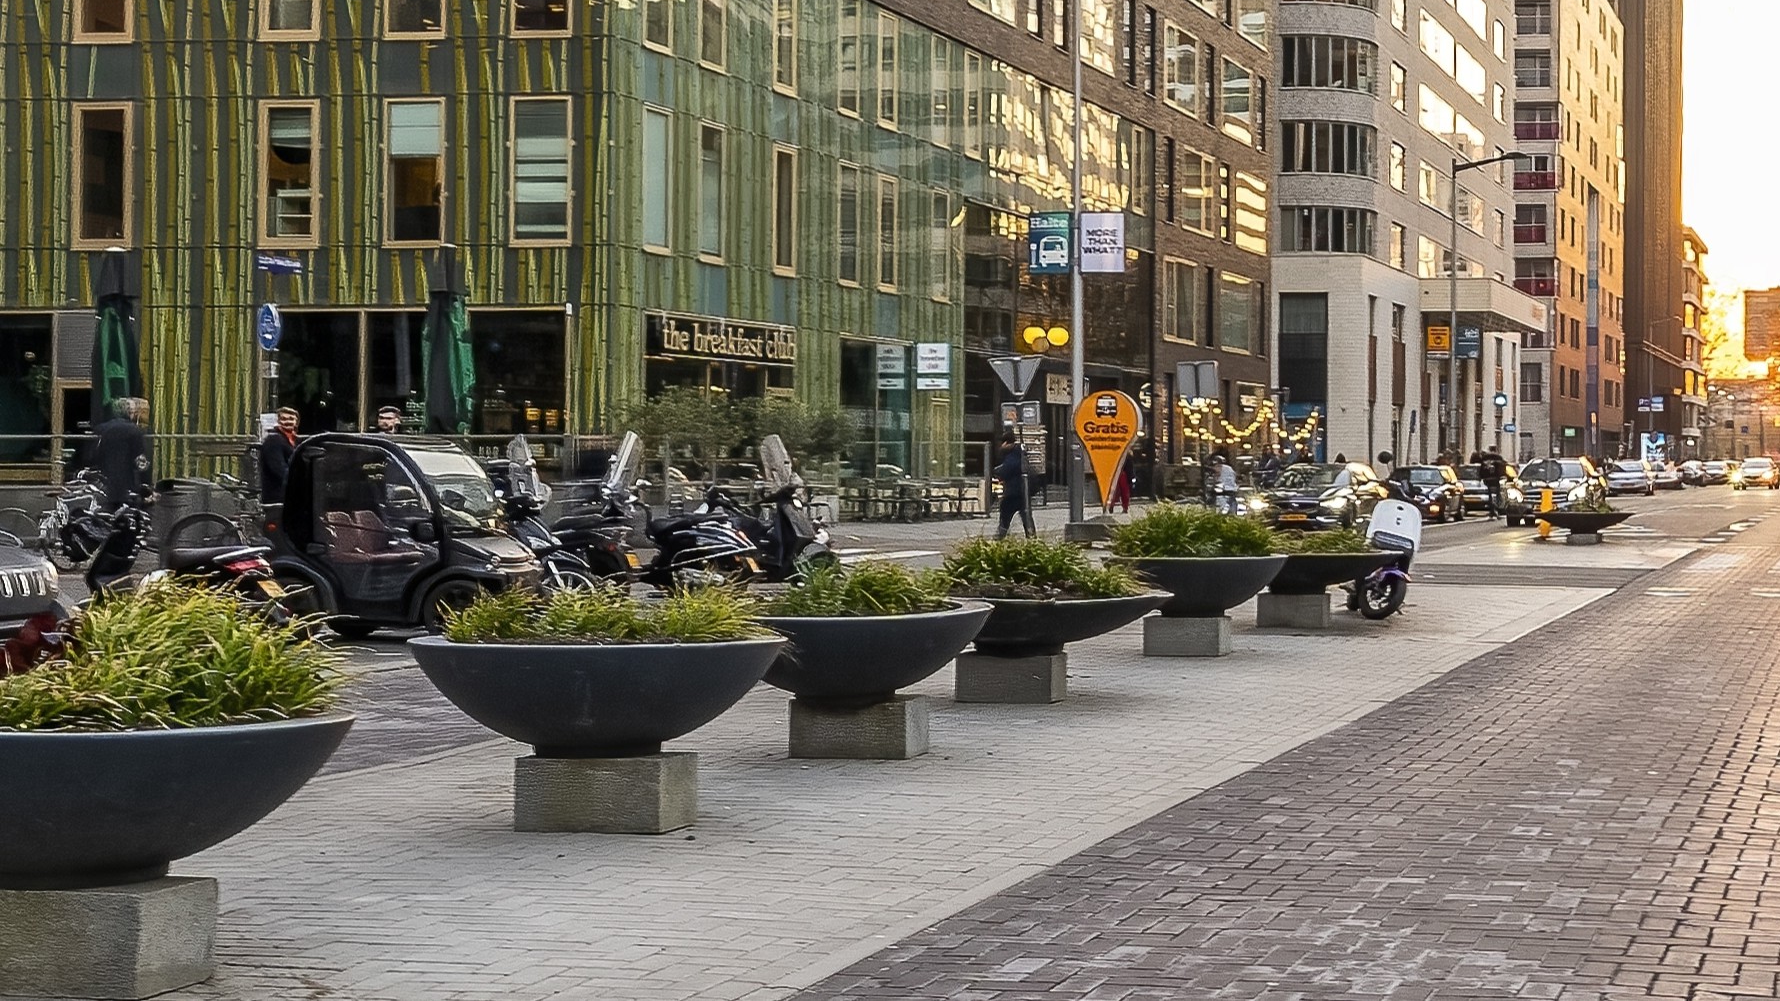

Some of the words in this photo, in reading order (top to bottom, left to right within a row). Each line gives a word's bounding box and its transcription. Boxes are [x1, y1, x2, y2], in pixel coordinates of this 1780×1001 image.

[1085, 229, 1118, 237] MORE
[663, 319, 690, 351] the
[693, 322, 763, 357] breakfast
[1083, 421, 1129, 434] Gratis
